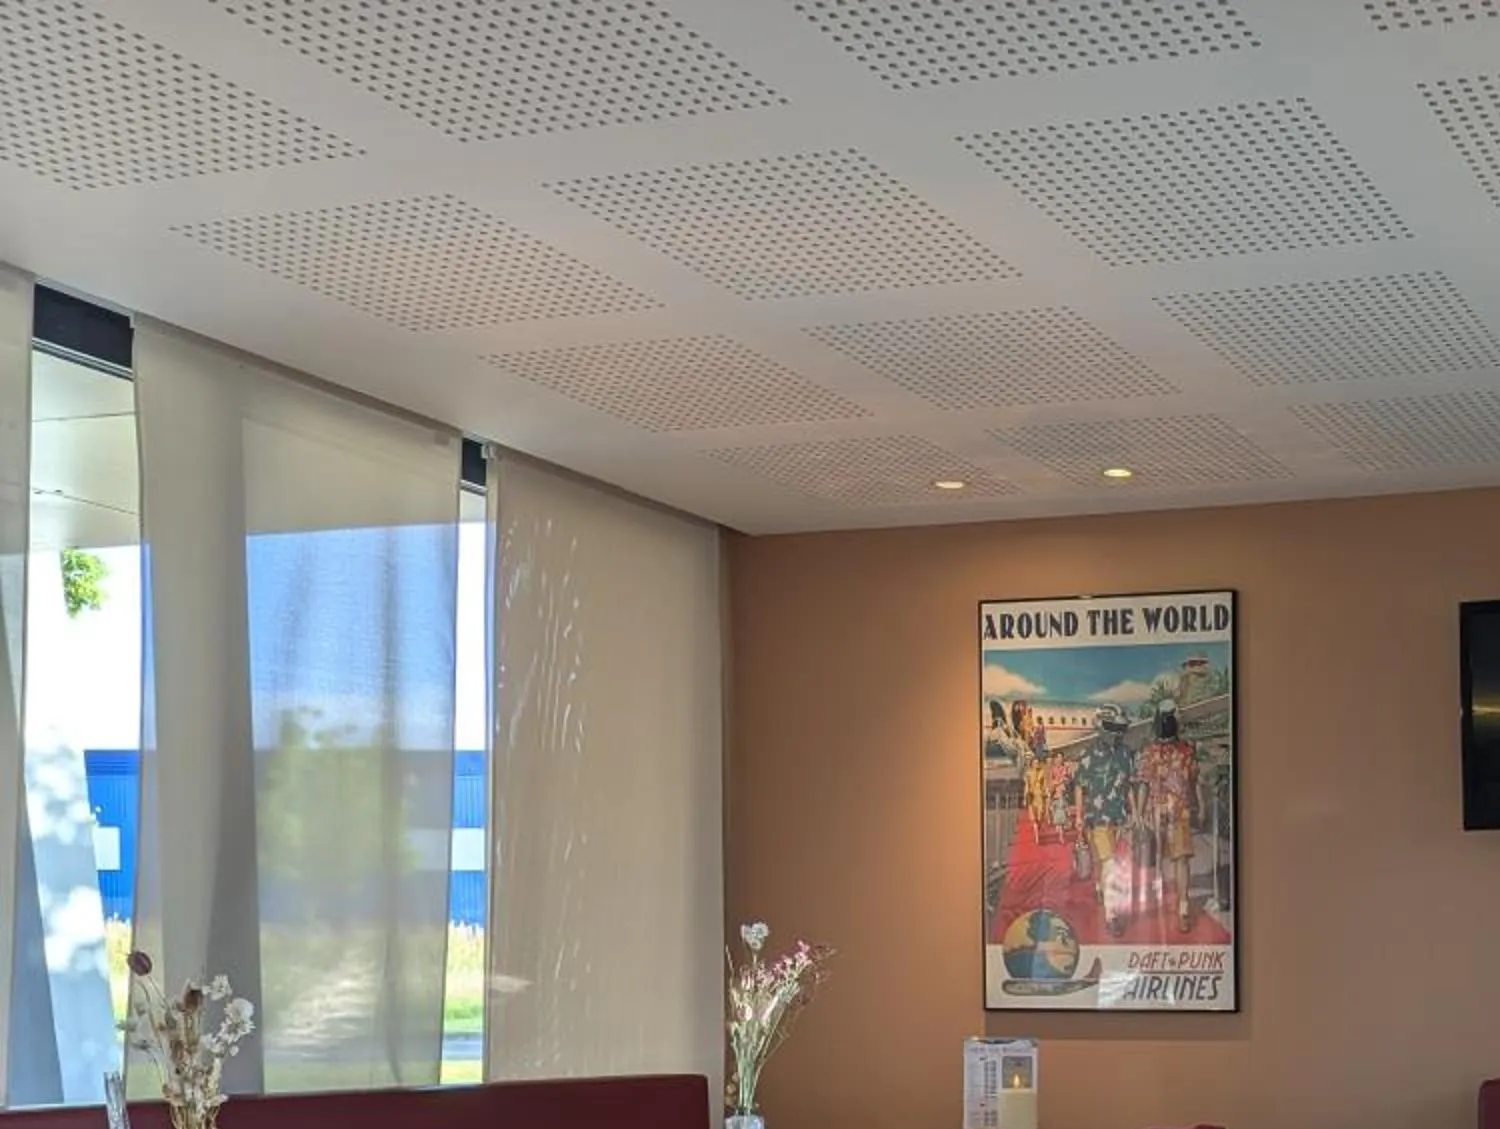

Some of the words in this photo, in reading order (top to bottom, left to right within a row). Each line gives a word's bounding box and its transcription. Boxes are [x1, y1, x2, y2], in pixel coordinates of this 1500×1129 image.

[984, 609, 1079, 640] AROUND
[1087, 608, 1134, 636] THE
[1142, 604, 1230, 633] WORLD
[1128, 951, 1171, 969] DAFT
[1178, 951, 1226, 970] PUNK
[1123, 975, 1223, 1000] AIRLINES
